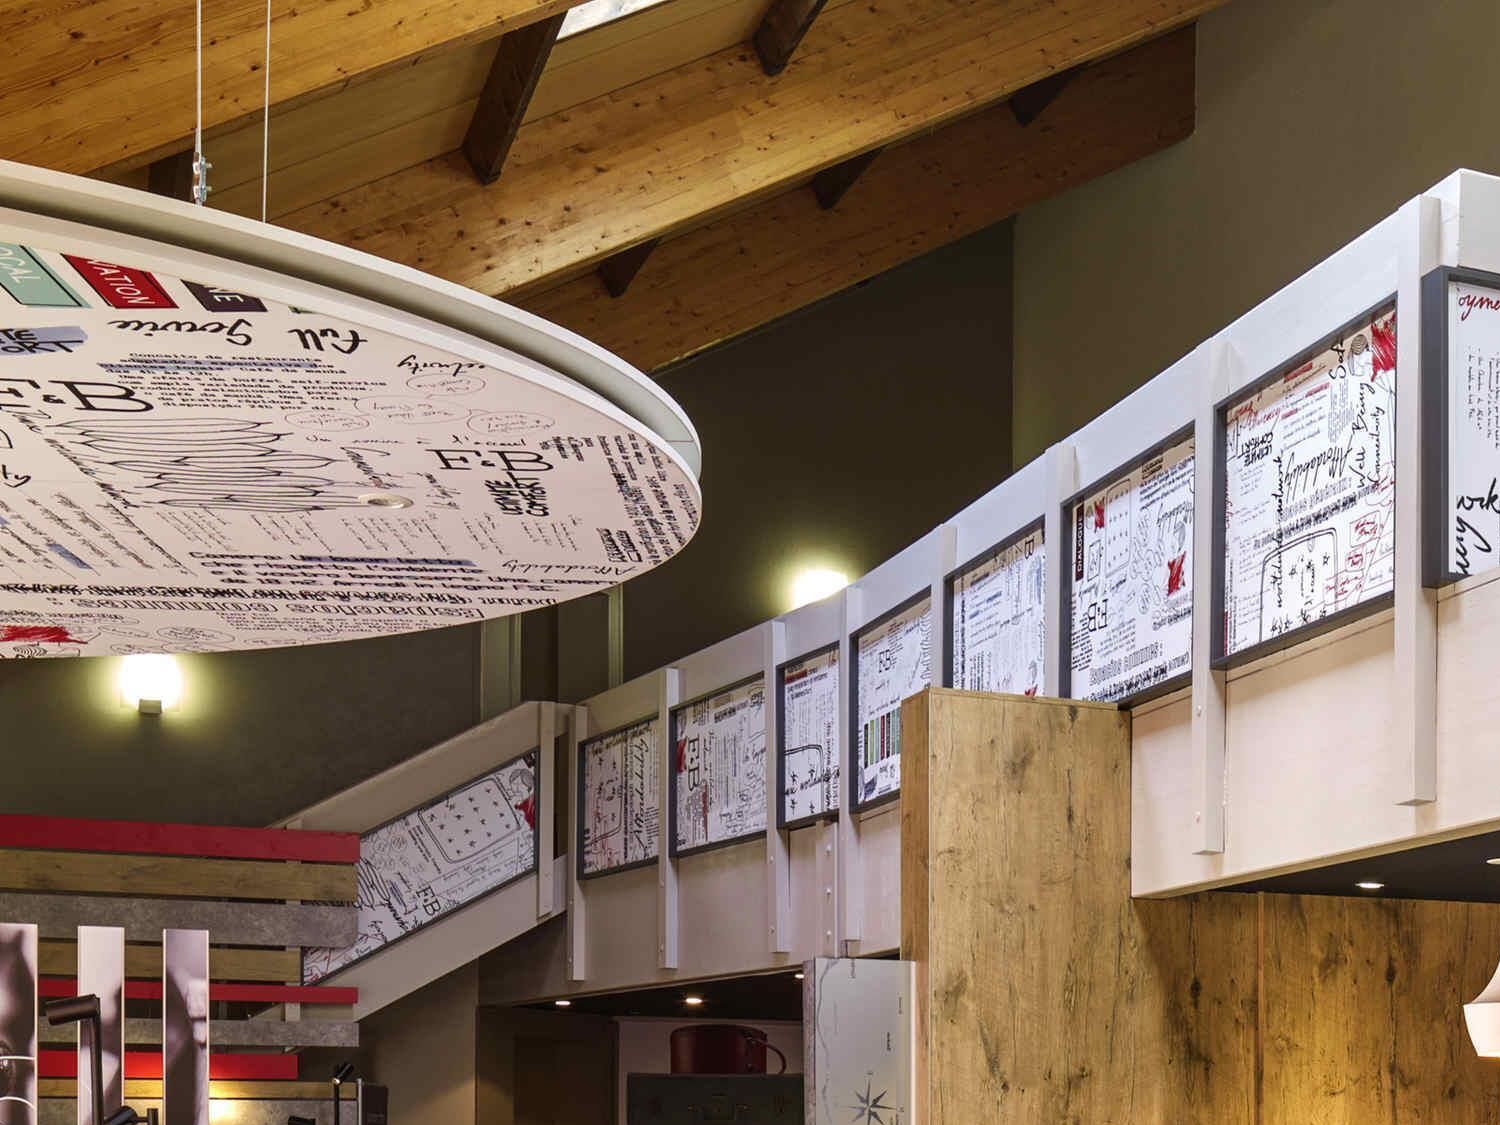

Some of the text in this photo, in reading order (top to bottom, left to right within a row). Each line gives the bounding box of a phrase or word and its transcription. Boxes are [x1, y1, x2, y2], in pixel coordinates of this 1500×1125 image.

[108, 319, 368, 355] Full Service
[1352, 382, 1376, 432] Being
[425, 448, 554, 472] F&B
[1350, 446, 1367, 488] Well
[485, 479, 525, 516] ULTIMATE
[506, 471, 551, 517] COMFORT
[1076, 515, 1084, 572] DIALOGUE
[253, 563, 358, 571] rispetta
[687, 736, 702, 792] F&B
